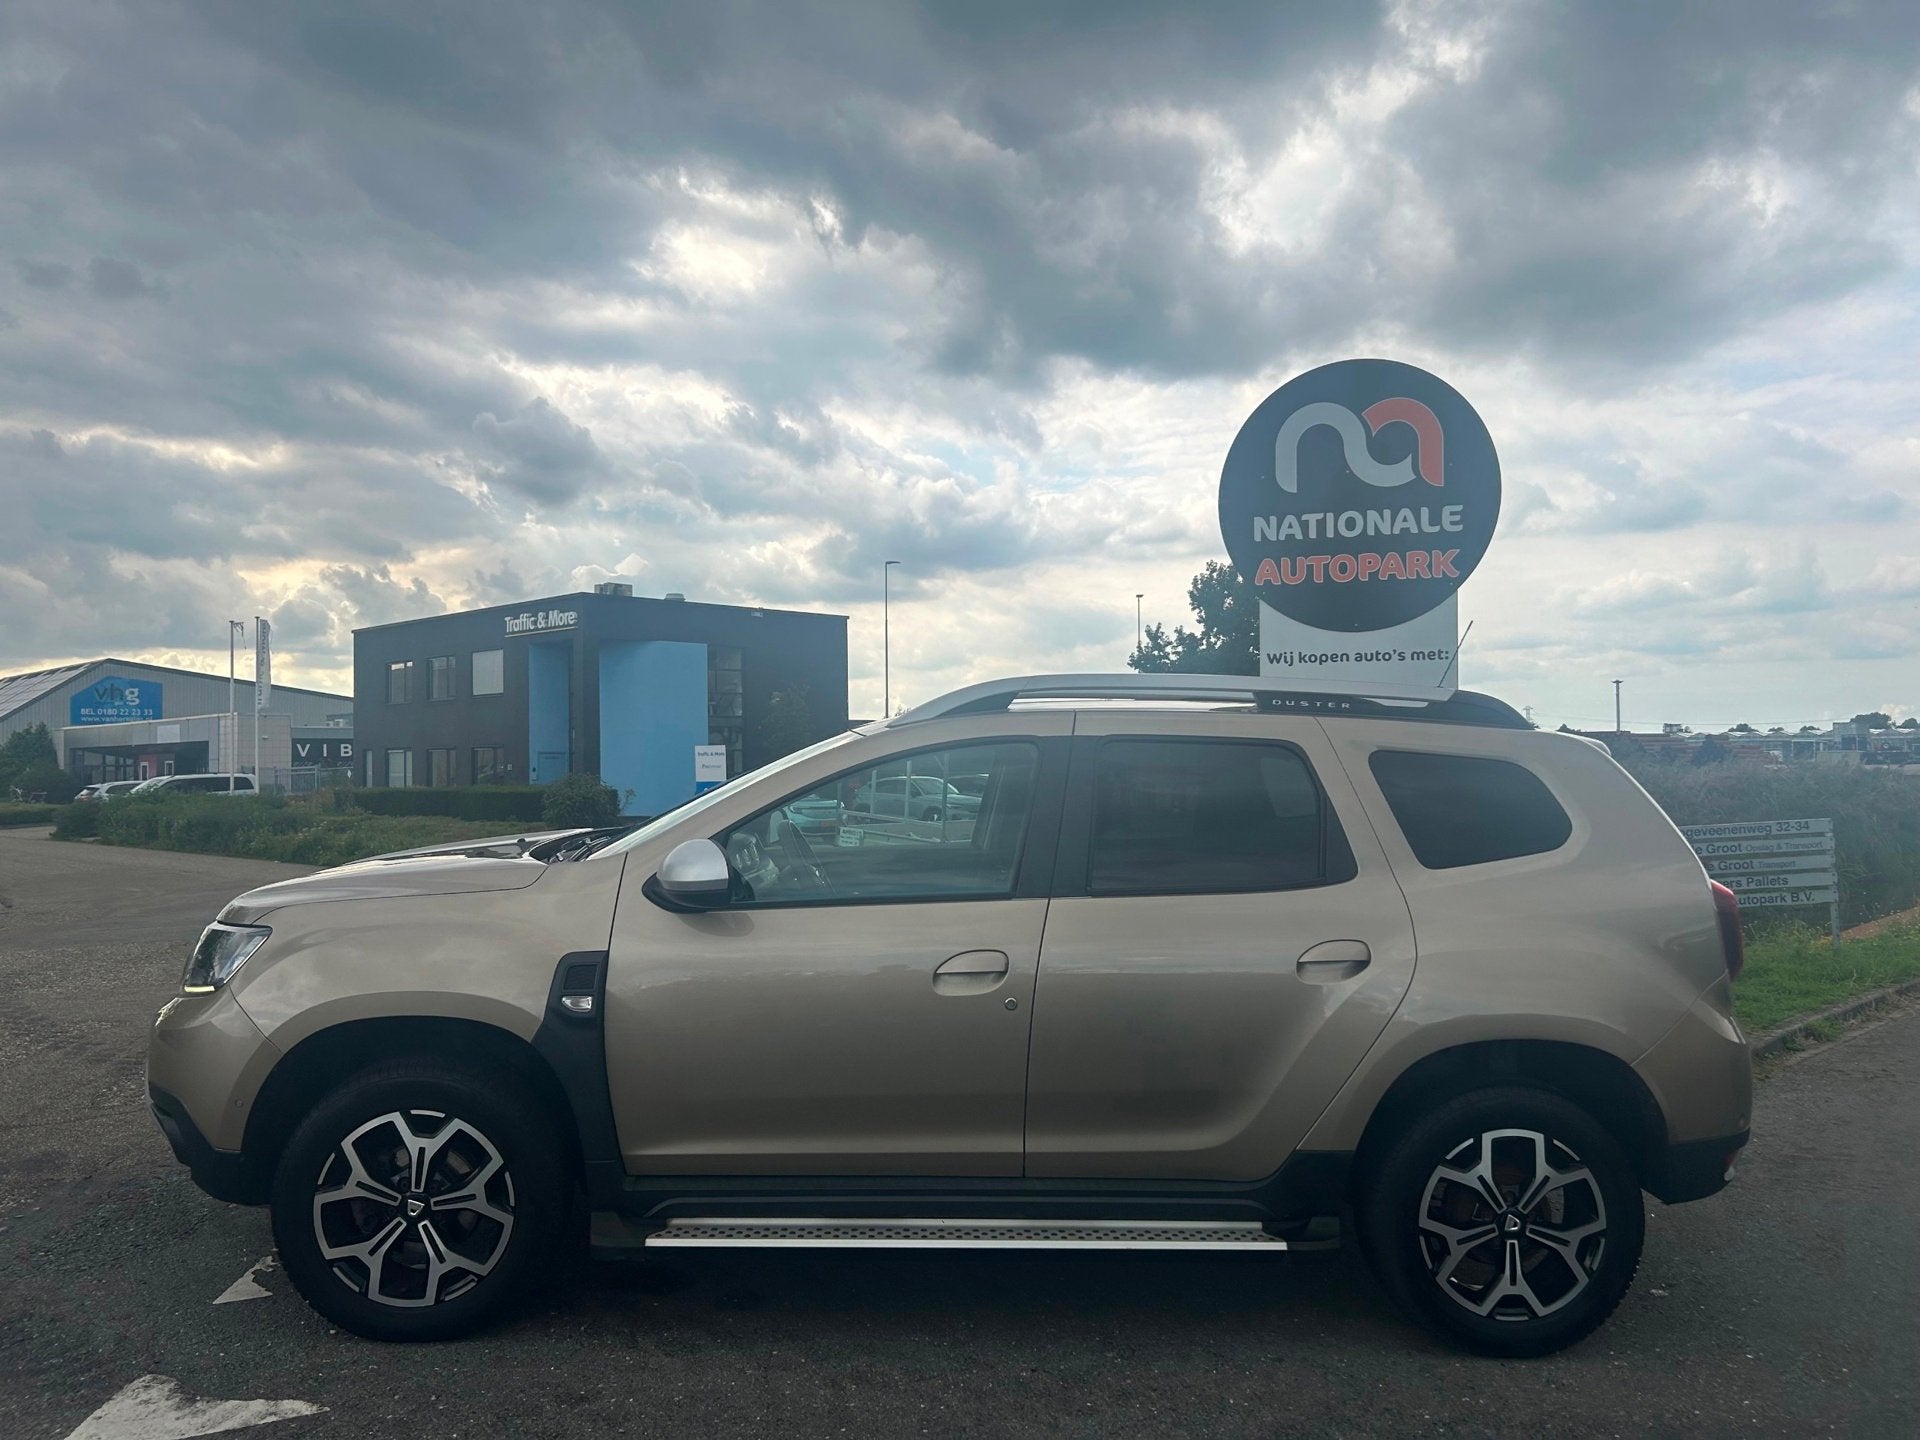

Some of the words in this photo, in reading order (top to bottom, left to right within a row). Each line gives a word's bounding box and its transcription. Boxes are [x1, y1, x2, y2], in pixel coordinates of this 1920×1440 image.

[1253, 504, 1464, 542] NATIONALE
[1255, 549, 1460, 586] AUTOPARK
[504, 612, 537, 633] Traffic
[537, 611, 547, 629] &
[548, 609, 578, 627] More
[1266, 651, 1294, 667] Wij
[1298, 651, 1350, 666] kopen
[1354, 649, 1406, 663] auto's
[1410, 648, 1449, 662] met:
[94, 682, 140, 706] vhg
[80, 707, 96, 716] BEL
[97, 707, 118, 716] 0180
[1272, 699, 1351, 709] DUSTER
[296, 743, 353, 758] VIB
[1775, 820, 1810, 833] 32-34
[1706, 842, 1743, 854] Groot
[1718, 859, 1755, 872] Groot
[1746, 875, 1789, 887] Pallets
[1737, 893, 1788, 906] utopark
[1790, 891, 1815, 902] B.V.
